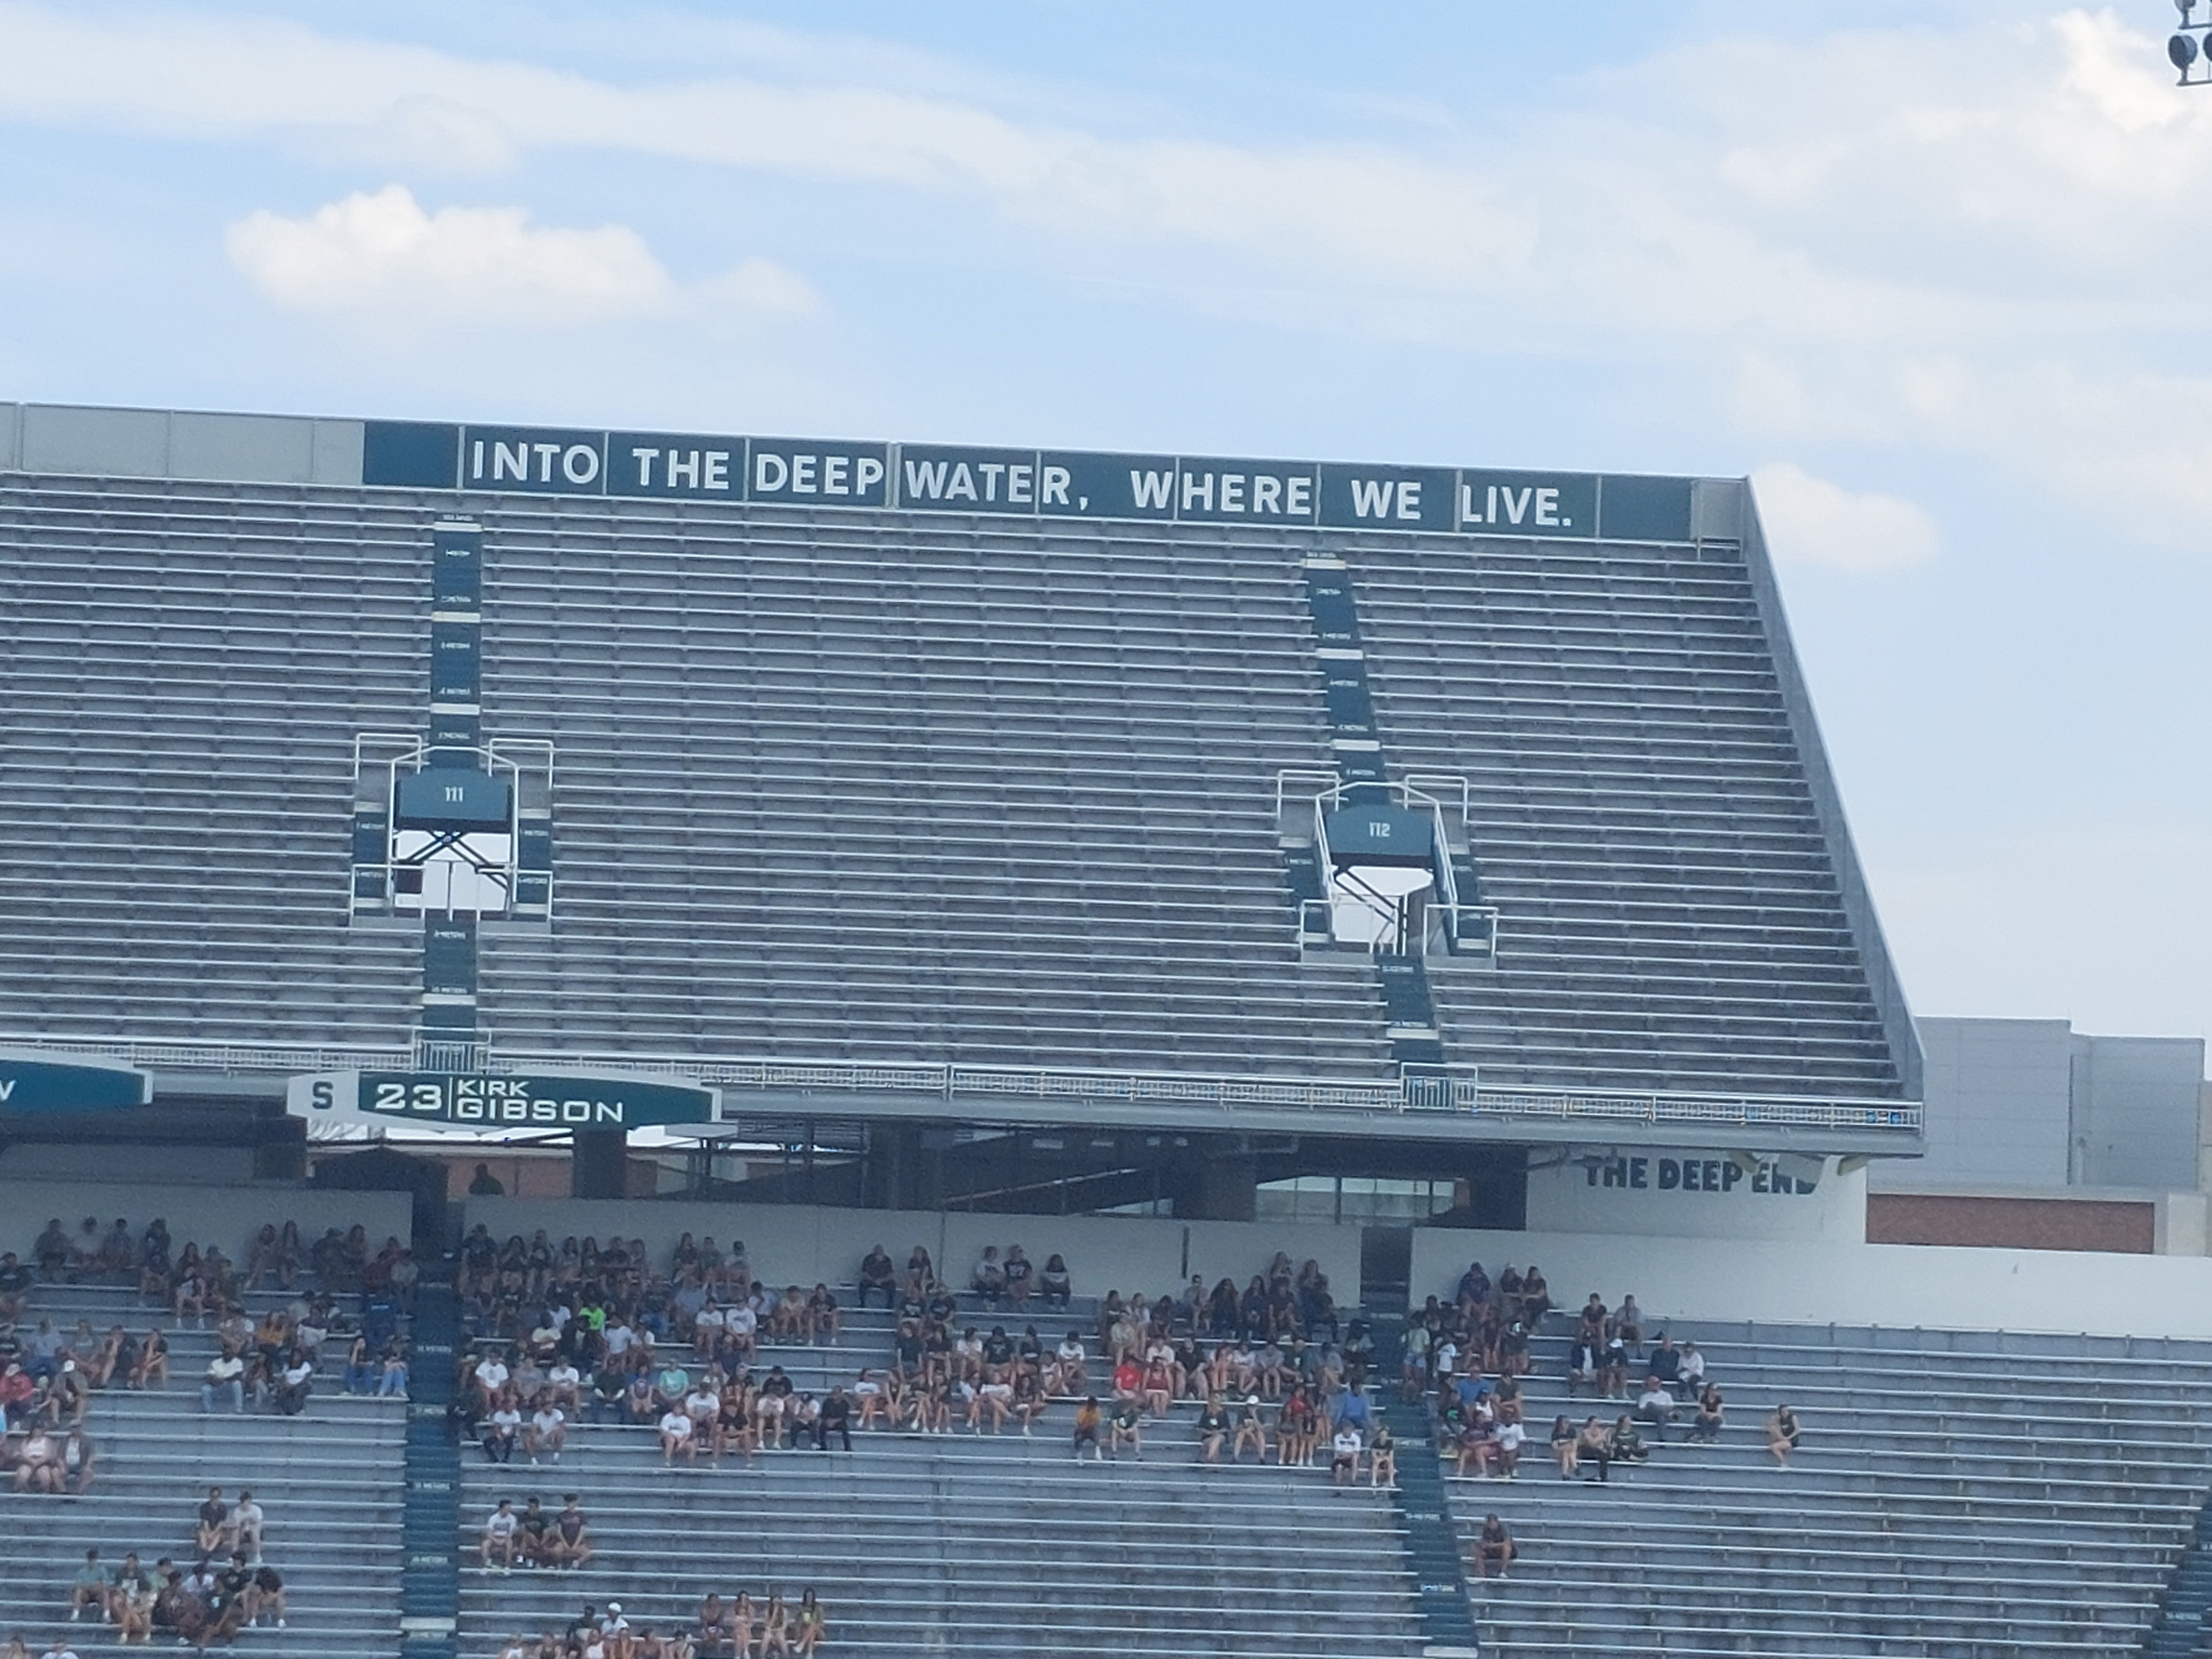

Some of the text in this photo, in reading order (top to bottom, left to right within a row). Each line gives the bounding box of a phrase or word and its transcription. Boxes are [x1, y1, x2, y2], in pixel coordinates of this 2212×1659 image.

[473, 441, 1571, 526] INTO THE DEEP WATER, WHERE WE LIVE.
[445, 786, 463, 802] 111
[1369, 822, 1391, 837] 112
[375, 1083, 442, 1110] 23
[457, 1079, 530, 1097] KIRK
[457, 1097, 622, 1123] GIBSON
[1582, 1156, 1648, 1189] THE
[1658, 1158, 1743, 1192] DEEP
